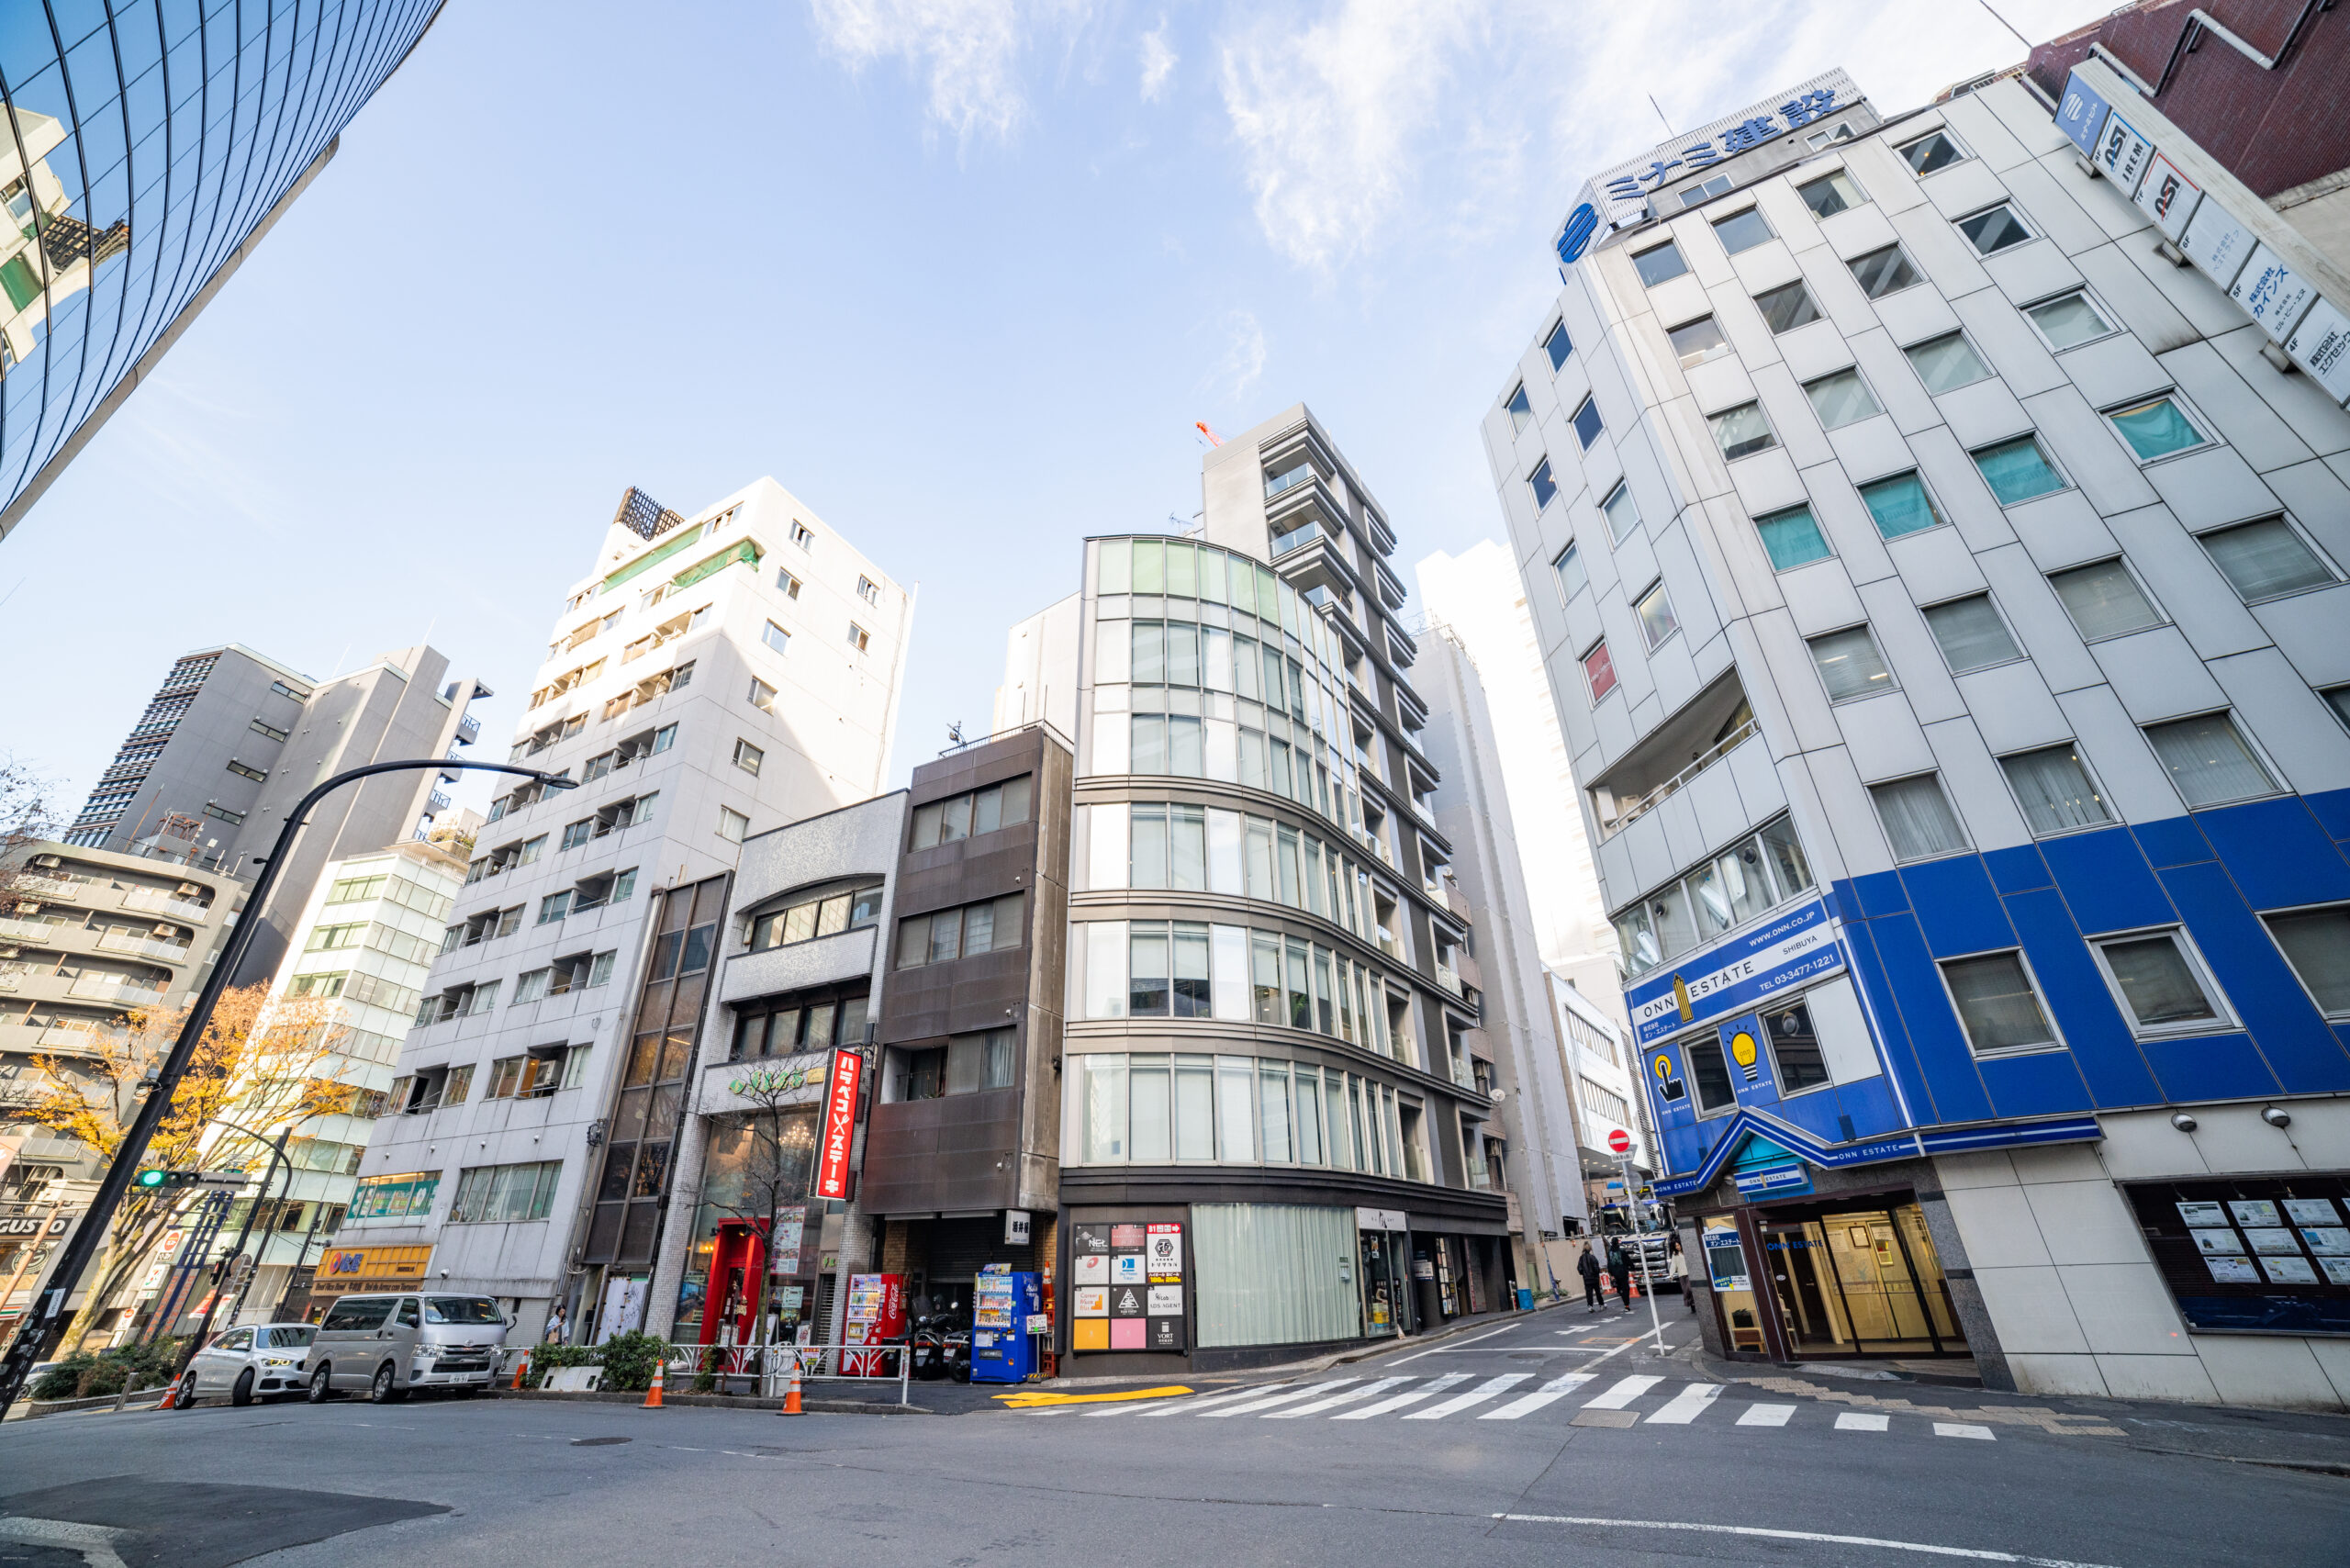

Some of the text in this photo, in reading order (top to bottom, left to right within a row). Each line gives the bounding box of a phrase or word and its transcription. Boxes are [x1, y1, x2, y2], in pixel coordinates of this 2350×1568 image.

[1606, 89, 1845, 201] ミナミ建設
[2095, 149, 2102, 162] 8F
[2121, 142, 2144, 183] JREM
[2136, 190, 2144, 202] 7F
[2182, 235, 2192, 248] 6F
[2211, 232, 2231, 263] 株式会社
[2232, 284, 2244, 298] 5F
[2249, 266, 2276, 303] 株式会社
[2253, 263, 2289, 319] カインズ
[2275, 293, 2292, 316] 株式会社
[2288, 338, 2299, 353] 4F
[2310, 330, 2339, 367] 株式会社
[1748, 912, 1815, 947] WWW.ONN.CO.JP
[1782, 935, 1818, 956] SHIBUYA
[1759, 955, 1835, 991] TEL 03-3477-1221
[1643, 960, 1754, 1018] ONN ESTATE
[1643, 1022, 1660, 1033] 株式会社
[1645, 1023, 1676, 1039] オン・エステート
[1751, 1080, 1773, 1092] ESTATE
[1673, 1103, 1691, 1114] ESTATE
[824, 1056, 855, 1193] ハラペコ ステーキ
[1838, 1144, 1899, 1161] ONN ESTATE
[1659, 1180, 1697, 1193] ONN ESTATE
[1749, 1173, 1787, 1185] ONN ESTATE
[1766, 1238, 1824, 1251] ONN ESTATE
